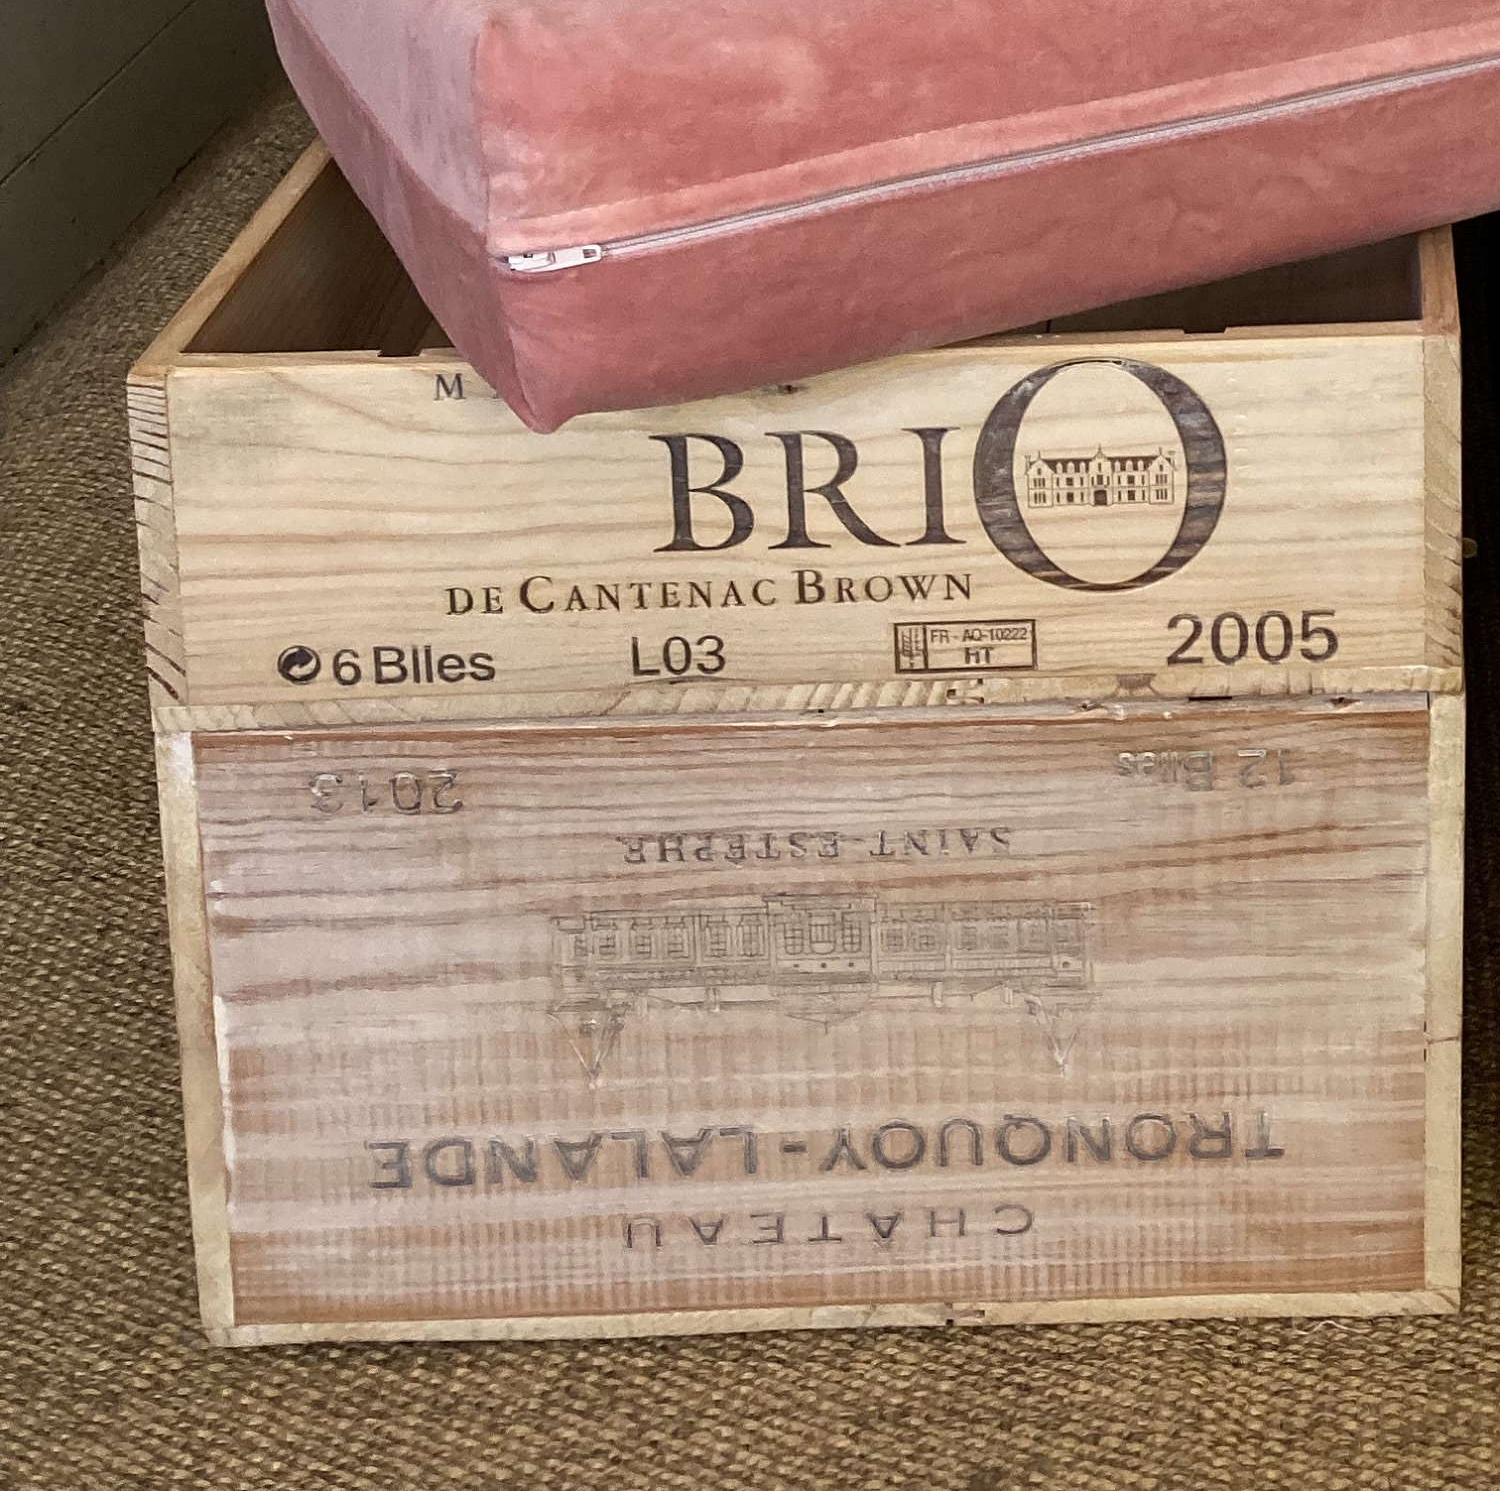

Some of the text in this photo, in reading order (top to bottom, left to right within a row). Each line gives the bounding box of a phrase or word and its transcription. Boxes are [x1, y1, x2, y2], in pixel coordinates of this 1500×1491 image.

[649, 356, 1227, 592] BRIO
[445, 569, 974, 615] DE CANTENAC BROWN
[631, 635, 726, 677] L03
[965, 647, 995, 664] HT
[1166, 610, 1339, 665] 2005
[332, 649, 362, 686] 6
[309, 769, 463, 814] 2013
